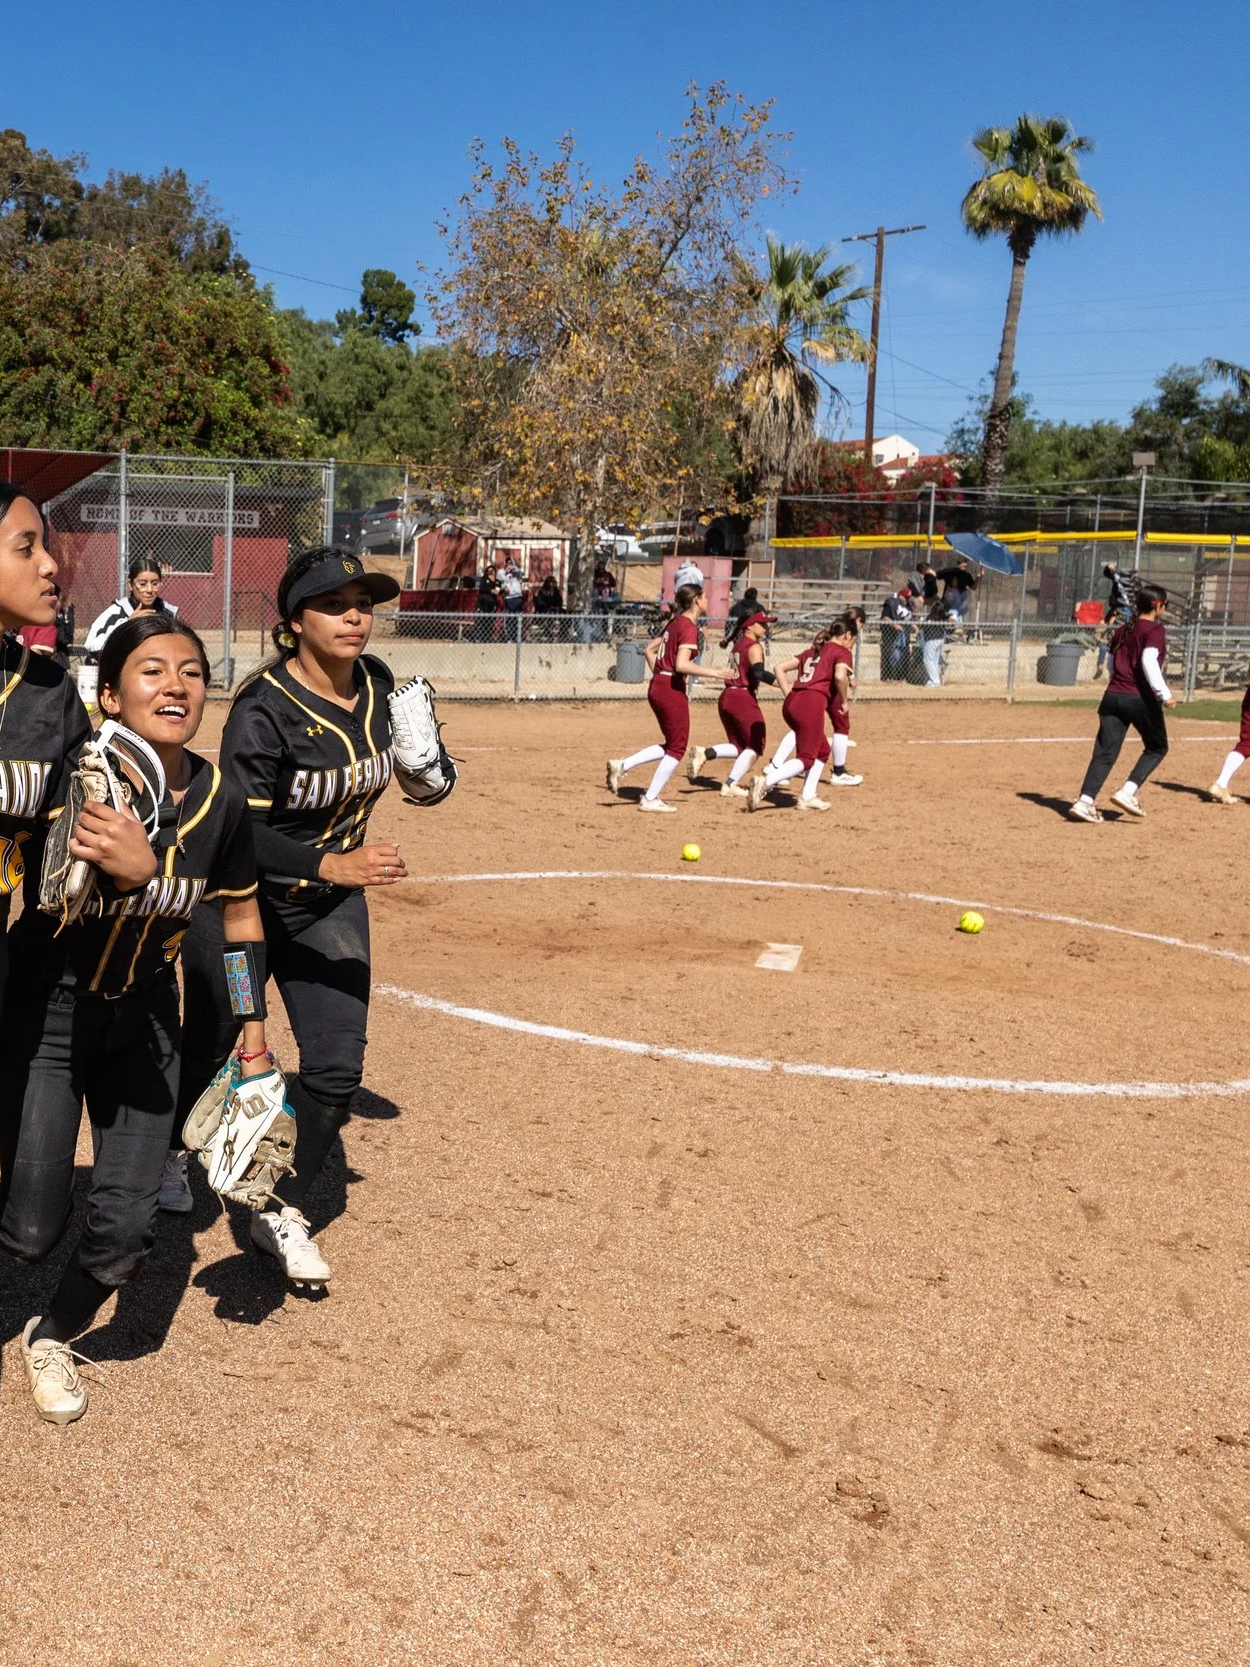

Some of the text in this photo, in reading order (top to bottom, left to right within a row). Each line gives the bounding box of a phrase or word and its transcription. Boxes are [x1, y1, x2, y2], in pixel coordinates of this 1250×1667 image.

[151, 509, 179, 522] THE
[185, 510, 254, 525] WARRORS
[285, 748, 395, 810] SAN FERNA
